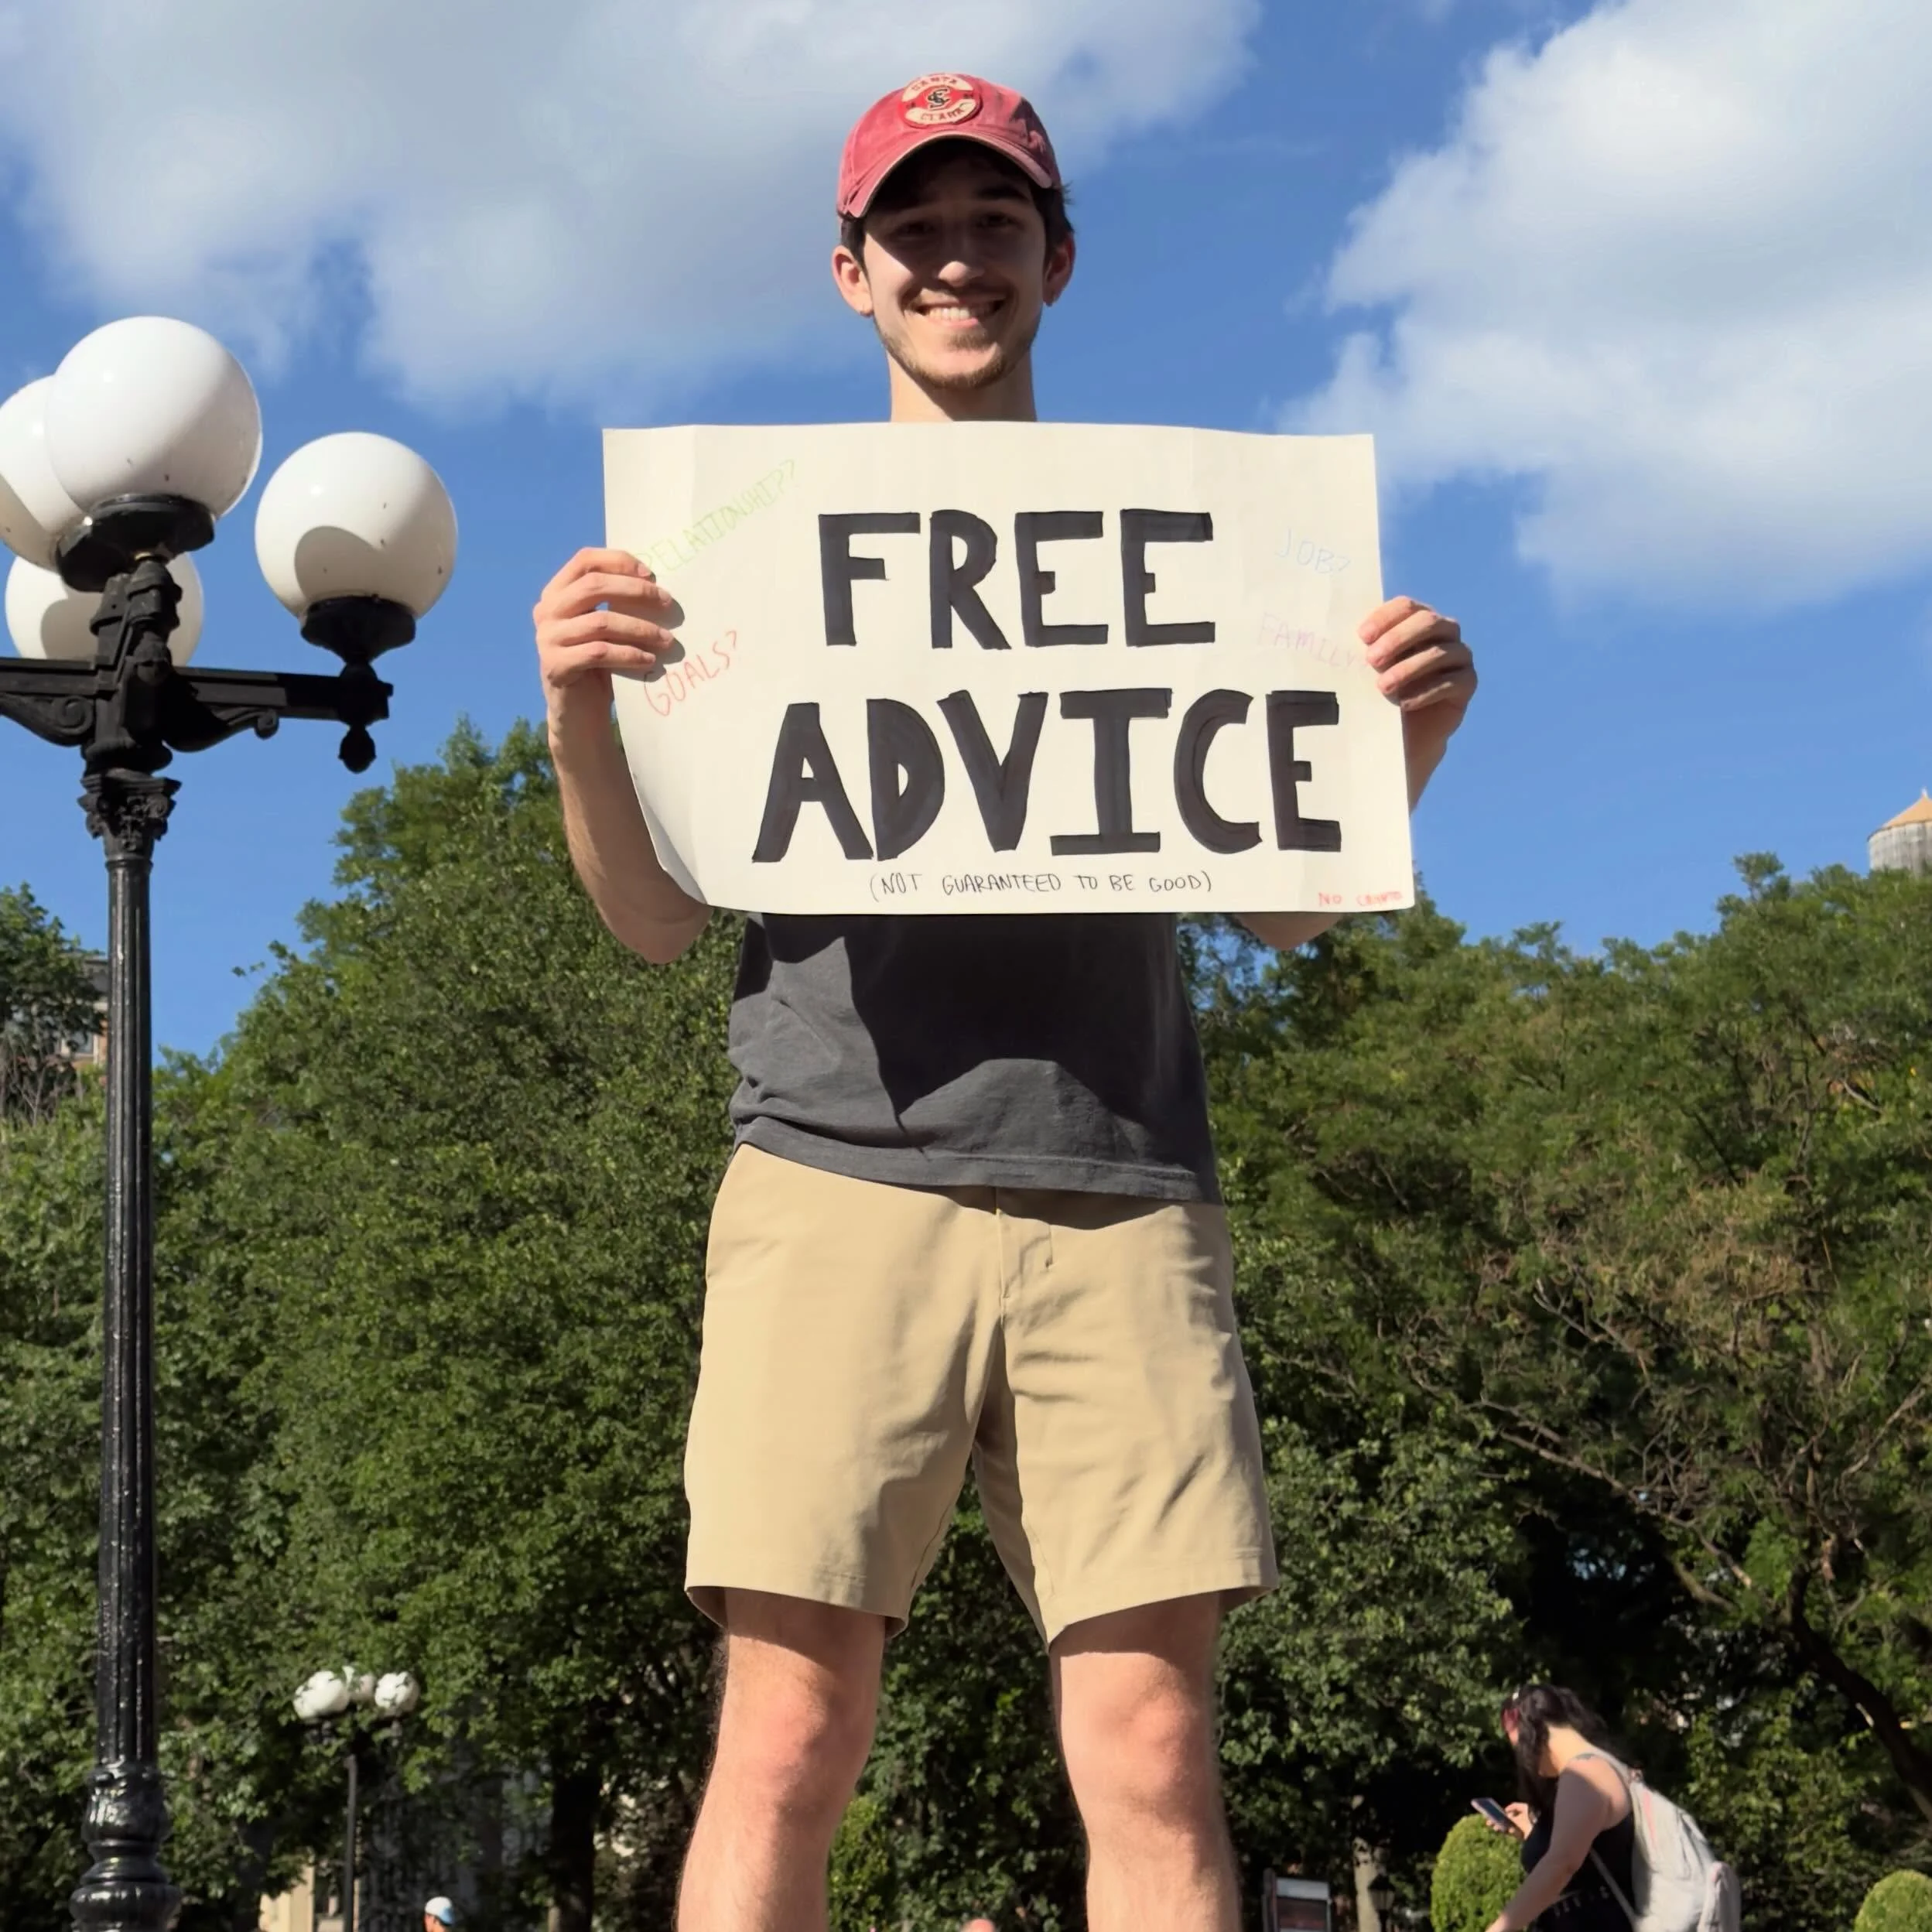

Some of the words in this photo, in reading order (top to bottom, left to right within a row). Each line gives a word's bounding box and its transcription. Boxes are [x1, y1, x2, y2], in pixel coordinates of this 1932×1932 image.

[819, 508, 1216, 650] FREE
[1274, 526, 1352, 574] JOB?
[644, 630, 737, 716] GOALS?
[752, 688, 1342, 862] ADVICE
[870, 873, 923, 903] (NOT
[942, 874, 1062, 896] GUARANTEED
[1075, 874, 1099, 891] TO
[1109, 874, 1135, 891] BE
[1148, 870, 1212, 892] GOOD)
